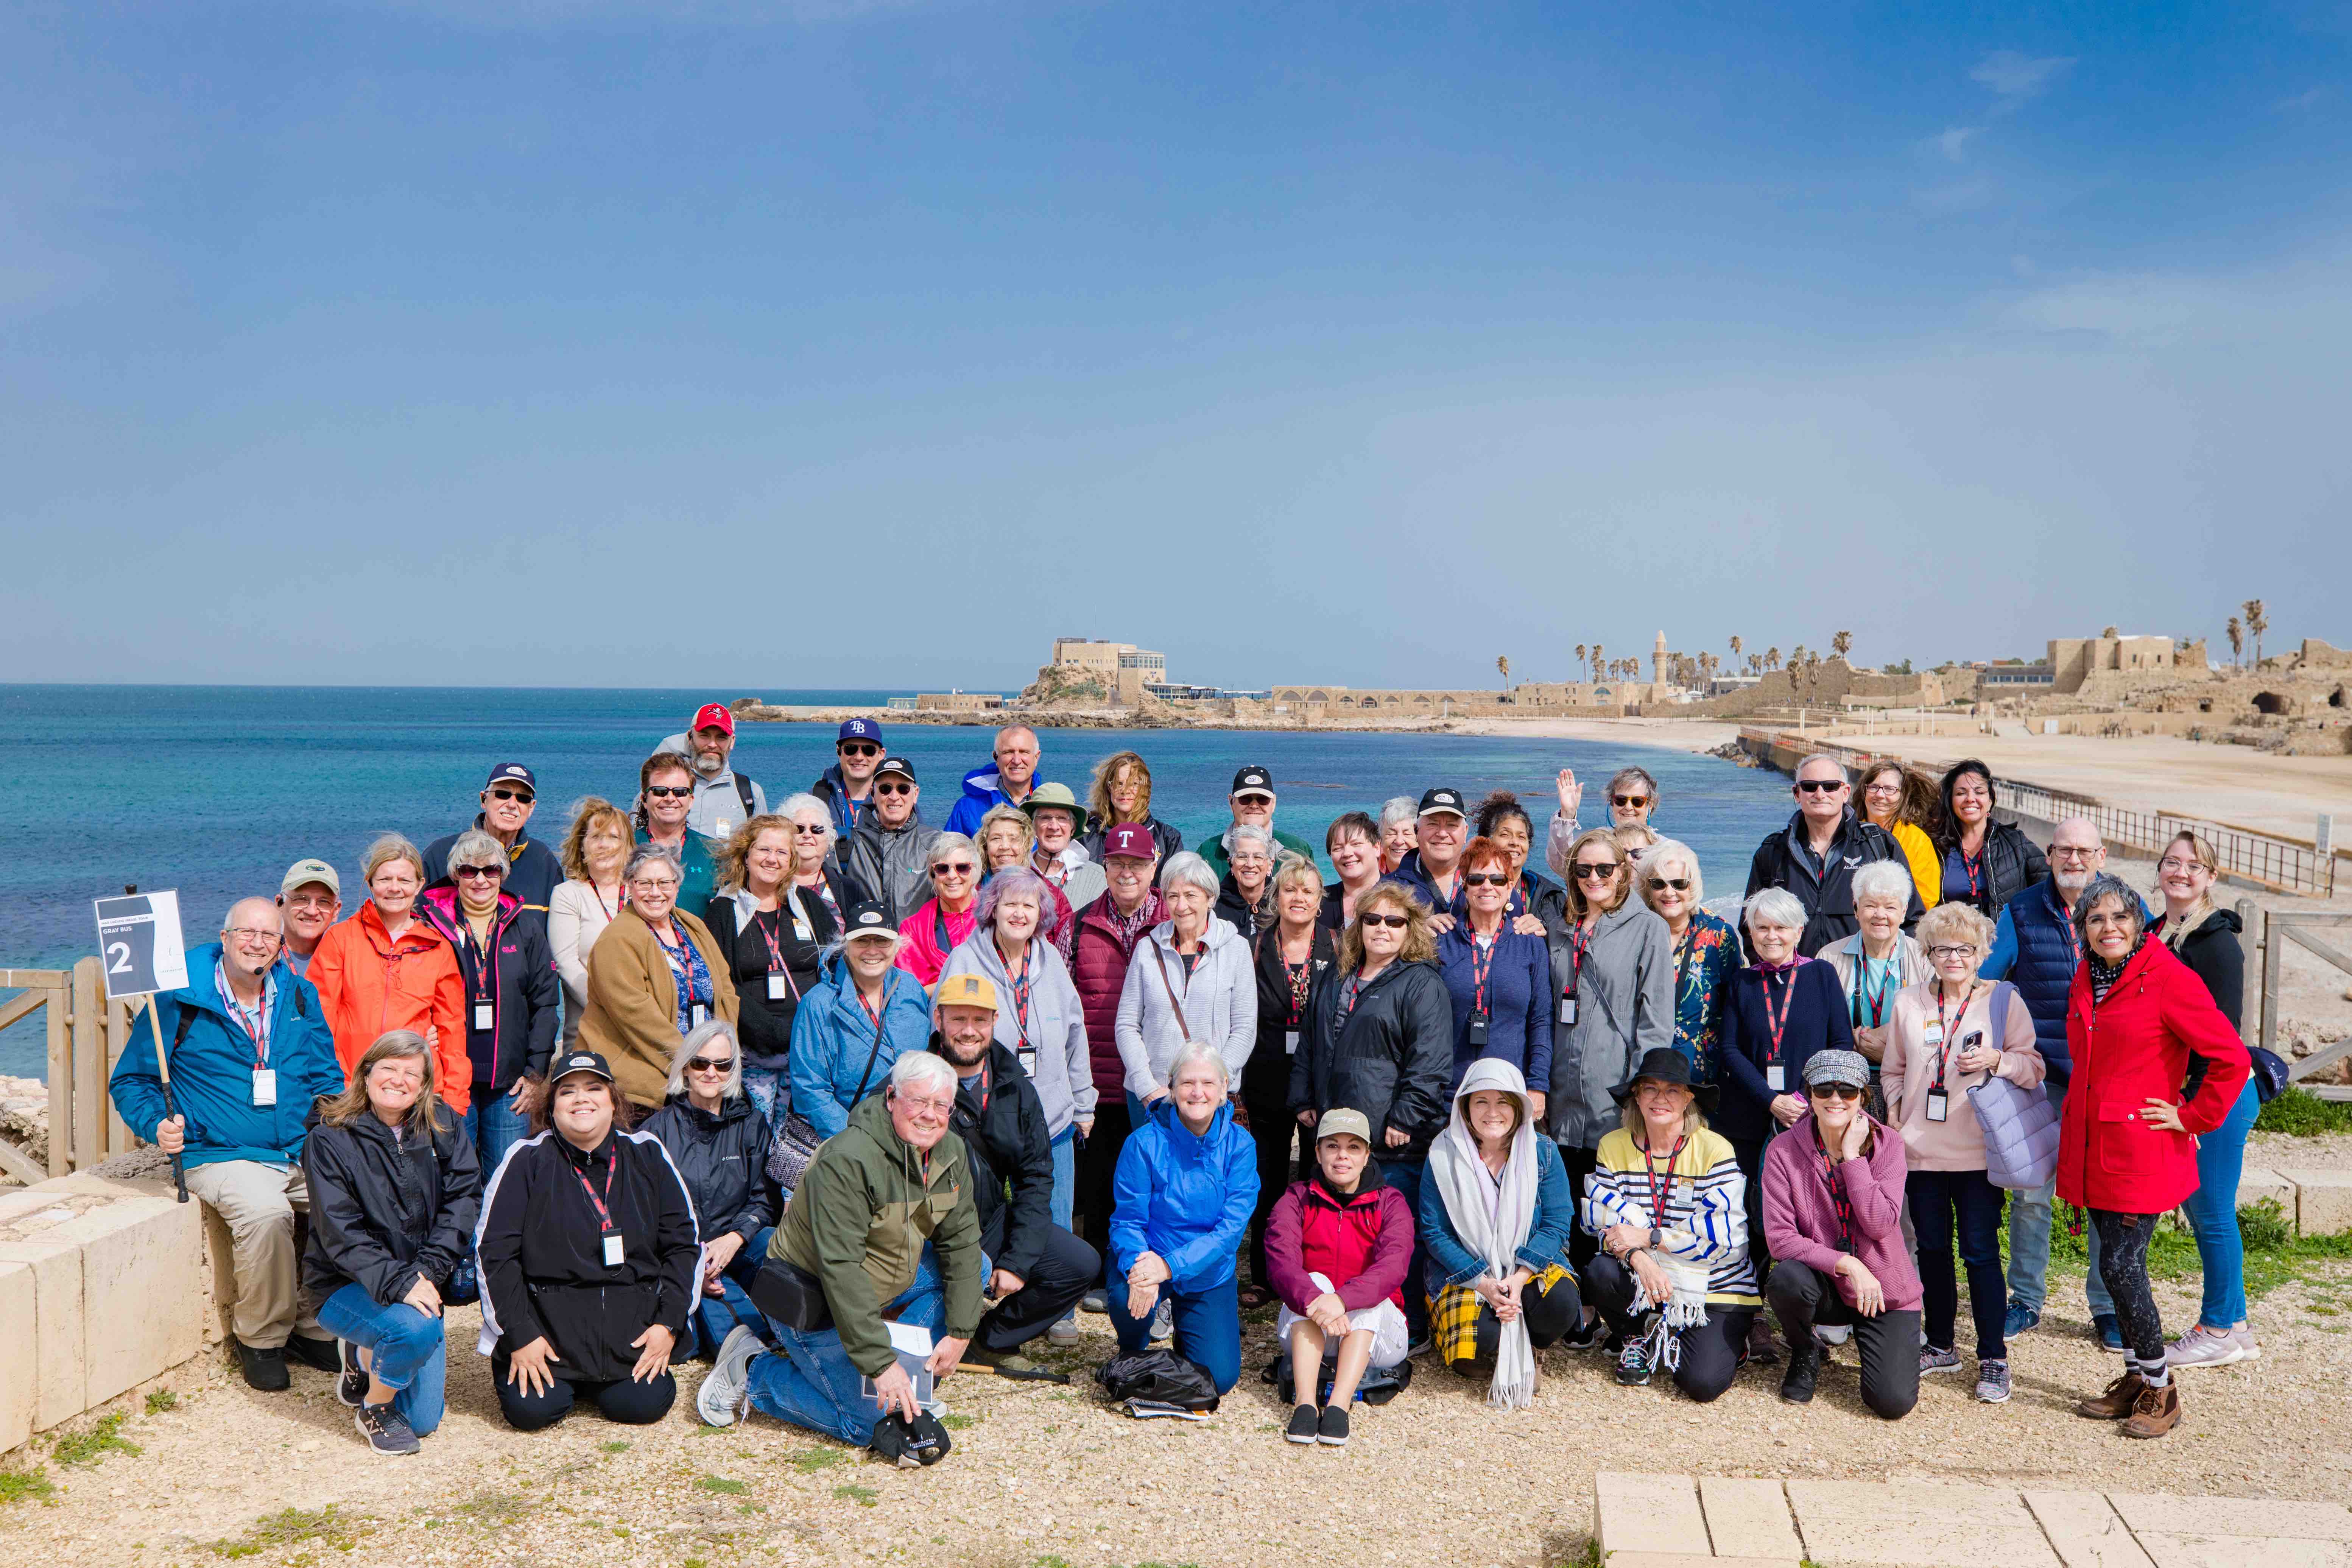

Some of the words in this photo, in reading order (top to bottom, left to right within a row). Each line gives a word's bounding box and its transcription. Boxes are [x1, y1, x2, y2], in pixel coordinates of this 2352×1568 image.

[850, 721, 865, 733] TB
[1119, 831, 1134, 848] T
[106, 942, 133, 974] 2
